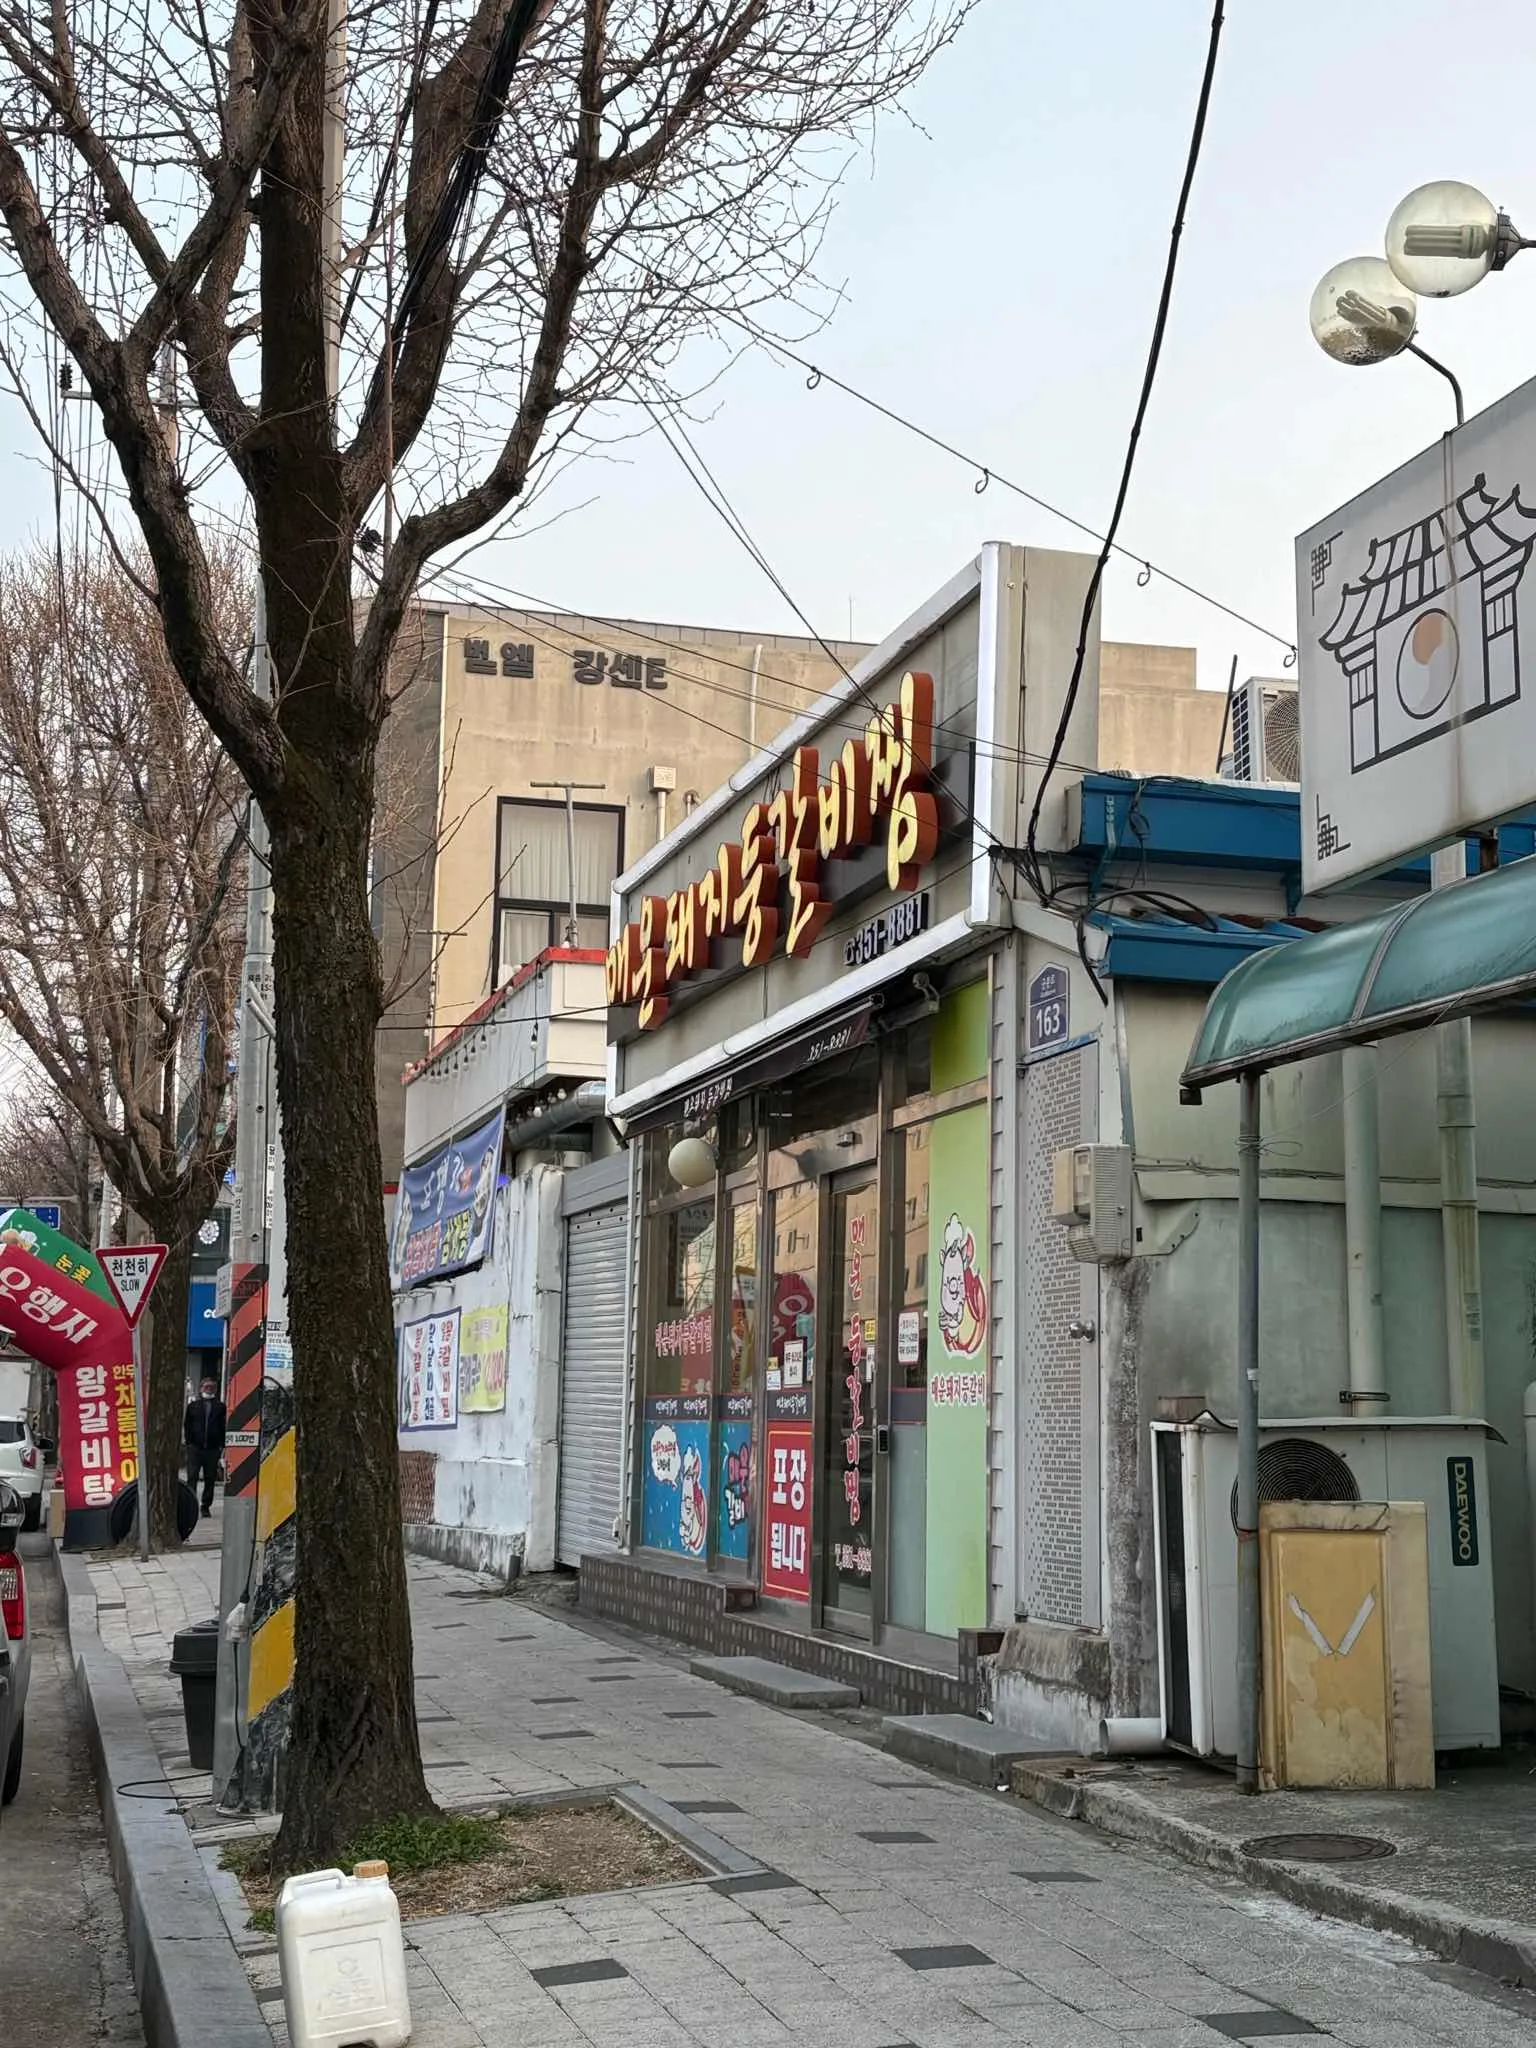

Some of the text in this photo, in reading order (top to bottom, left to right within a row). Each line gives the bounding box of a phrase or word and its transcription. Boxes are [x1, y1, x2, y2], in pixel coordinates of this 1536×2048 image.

[605, 671, 938, 1031] 매운돼지등갈비찜
[1035, 1002, 1061, 1039] 163
[55, 1253, 92, 1285] 눈꽃
[111, 1256, 149, 1277] 천천히
[120, 1278, 141, 1293] SLOW
[931, 1372, 986, 1407] 매운돼지등갈비
[75, 1363, 116, 1507] 왕갈비탕
[114, 1381, 140, 1483] 차돌박이
[772, 1446, 807, 1512] 포장
[723, 1485, 748, 1529] 갈비
[1454, 1462, 1473, 1561] DAEWOO
[770, 1520, 807, 1576] 됩니다
